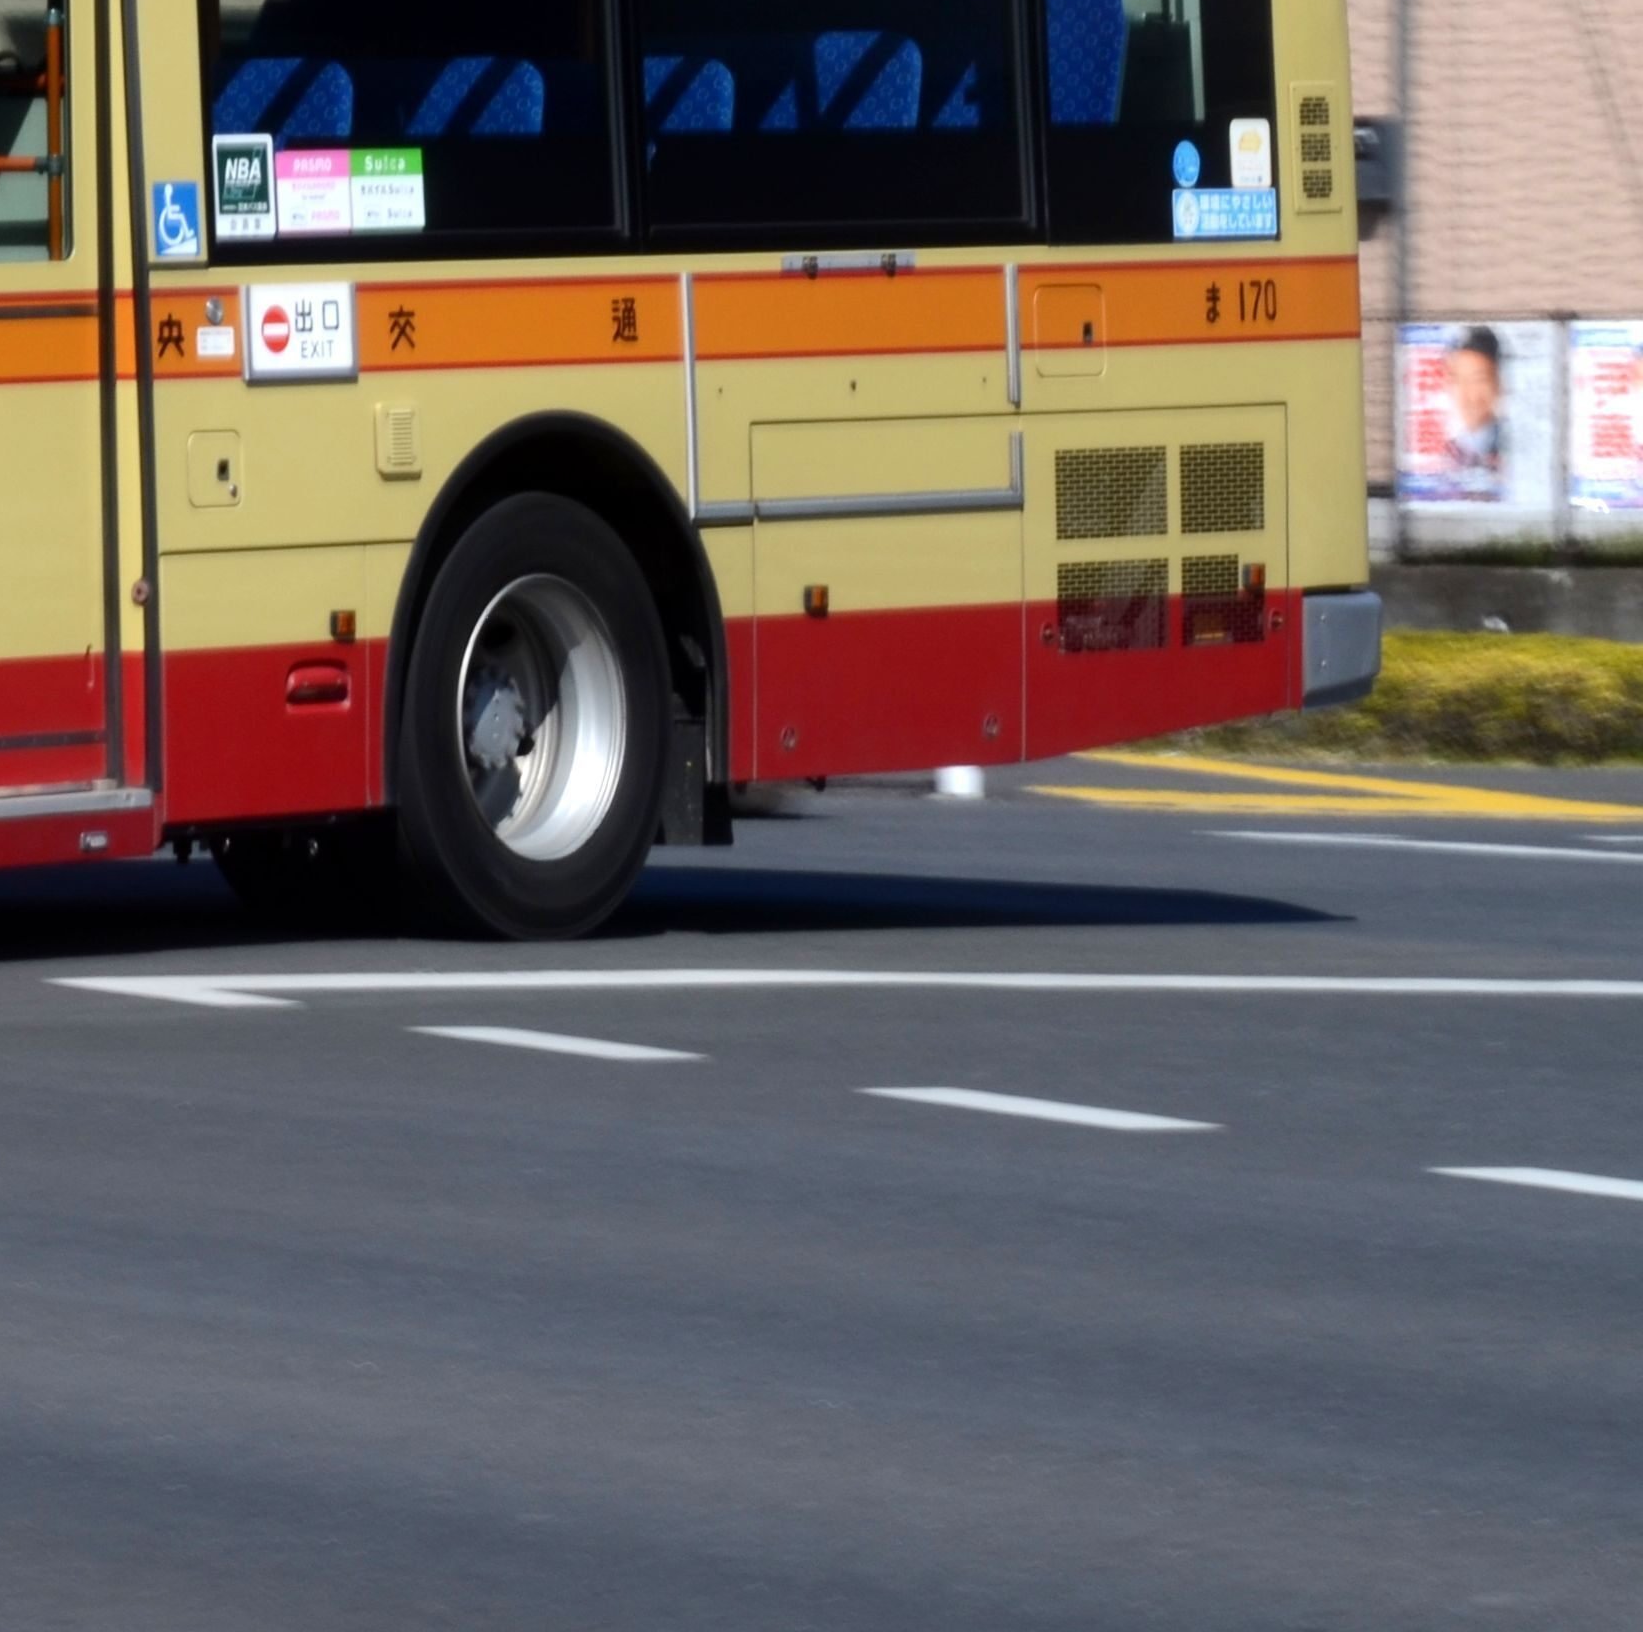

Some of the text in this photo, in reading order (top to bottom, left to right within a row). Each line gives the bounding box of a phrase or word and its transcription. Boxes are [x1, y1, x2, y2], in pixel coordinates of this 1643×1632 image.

[225, 157, 261, 185] NBA
[292, 158, 332, 173] PASMO
[364, 155, 407, 172] Suica
[1206, 278, 1277, 323] ま 170
[295, 299, 340, 333] 出口
[300, 339, 335, 359] EXIT
